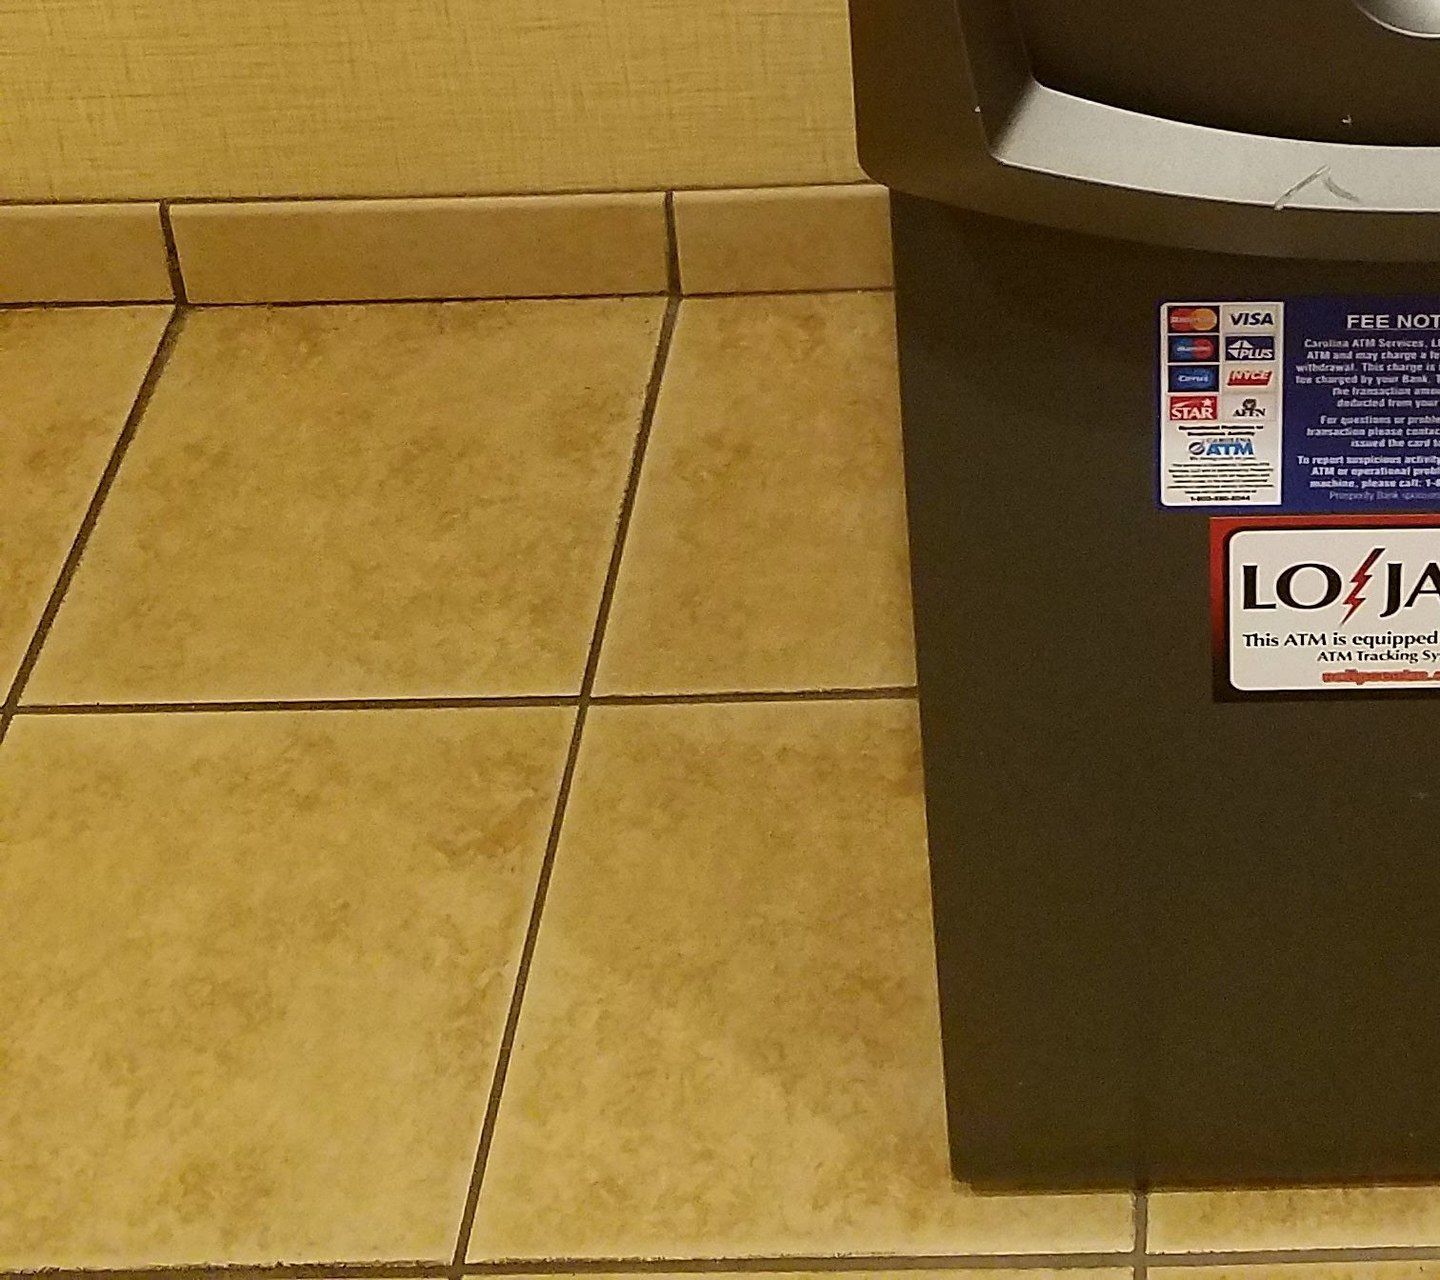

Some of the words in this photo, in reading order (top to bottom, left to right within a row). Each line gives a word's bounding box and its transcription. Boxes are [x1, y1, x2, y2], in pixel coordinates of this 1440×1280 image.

[1230, 313, 1273, 325] VISA
[1347, 314, 1390, 329] FEE
[1304, 339, 1350, 348] Carolina
[1352, 339, 1376, 348] ATM
[1239, 348, 1273, 359] PLUS
[1171, 407, 1214, 419] STAR
[1206, 442, 1254, 455] ATM
[1297, 455, 1310, 464] To
[1312, 455, 1344, 465] report
[1346, 455, 1402, 465] suspicious
[1310, 467, 1335, 475] ATM
[1337, 467, 1348, 475] or
[1351, 467, 1411, 476] operational
[1243, 562, 1343, 610] LO
[1243, 632, 1279, 647] This
[1284, 633, 1327, 646] ATM
[1333, 632, 1347, 646] is
[1352, 631, 1439, 649] equipped
[1316, 650, 1353, 662] ATM
[1357, 649, 1419, 664] Tracking
